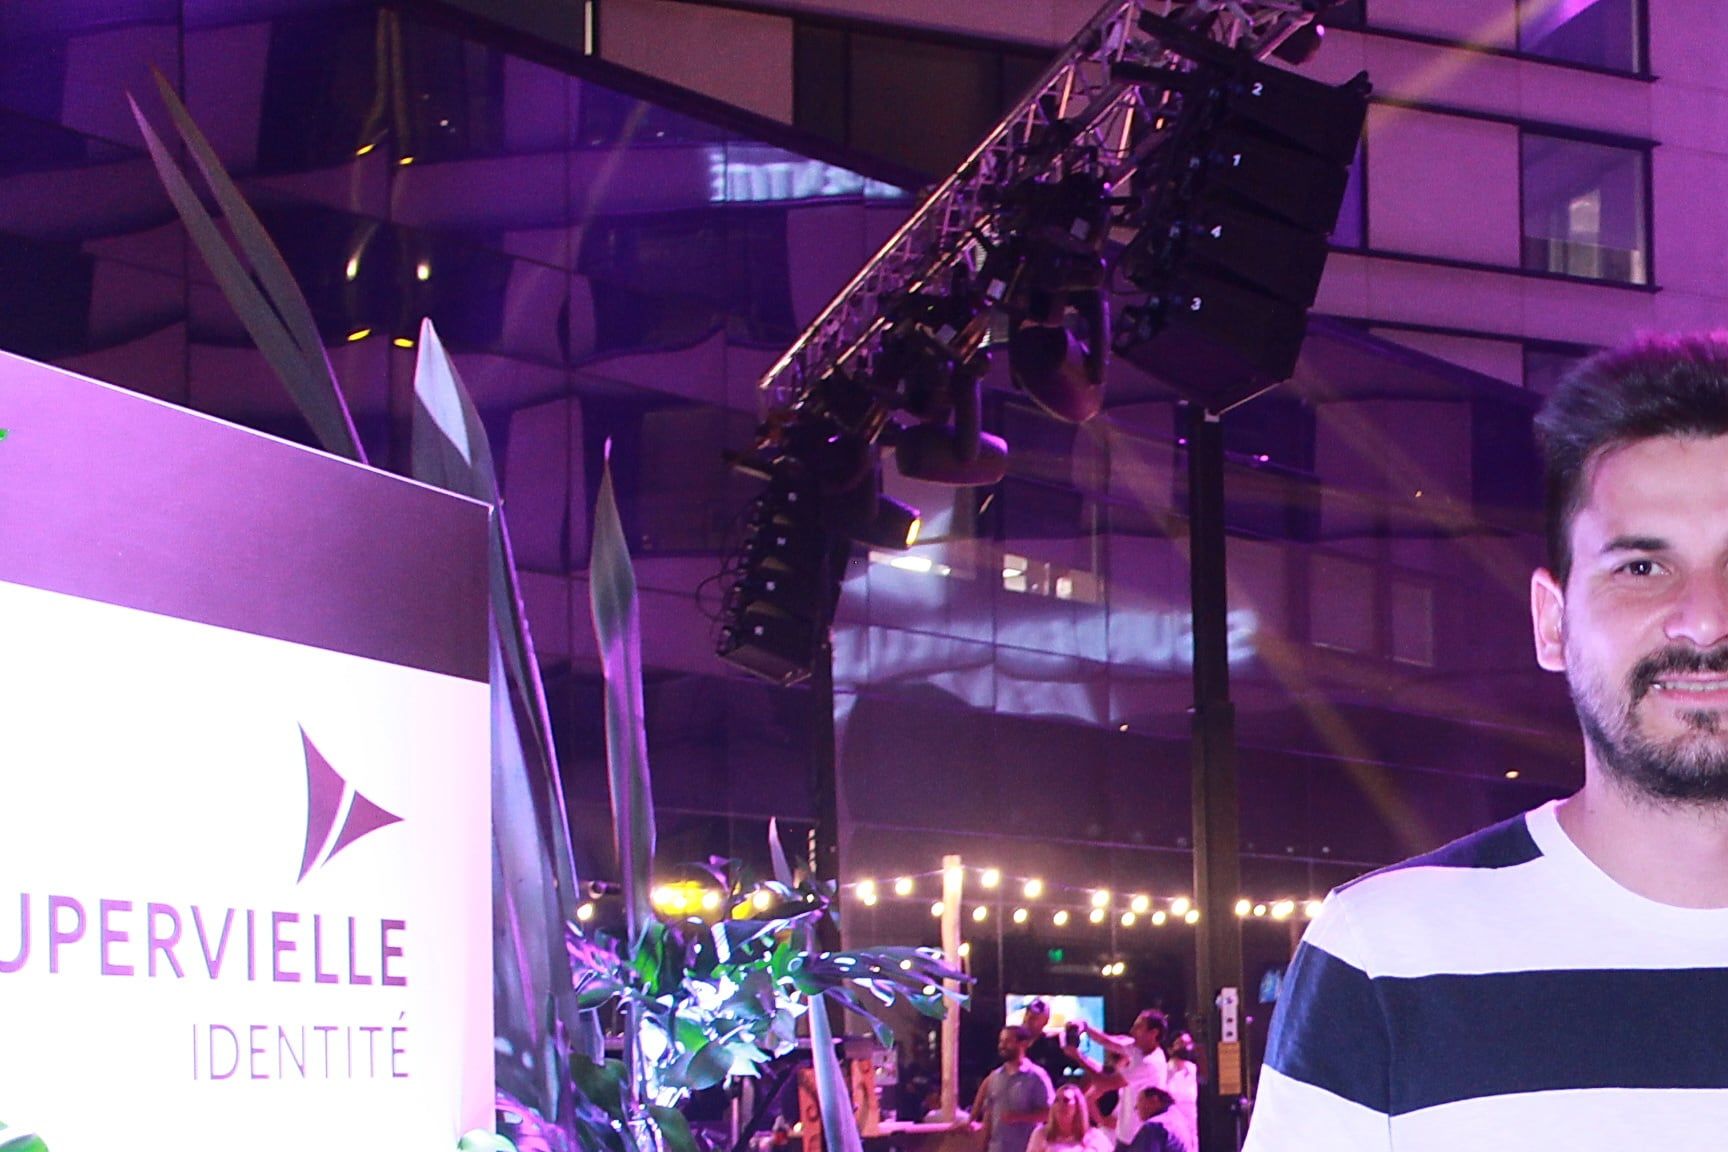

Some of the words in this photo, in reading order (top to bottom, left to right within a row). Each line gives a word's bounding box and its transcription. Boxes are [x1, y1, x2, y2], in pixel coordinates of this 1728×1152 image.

[1252, 82, 1263, 96] 2
[1233, 154, 1241, 166] 1
[1191, 297, 1201, 310] 3
[0, 892, 409, 988] UPERVIELLE
[192, 1010, 410, 1081] IDENTITÉ
